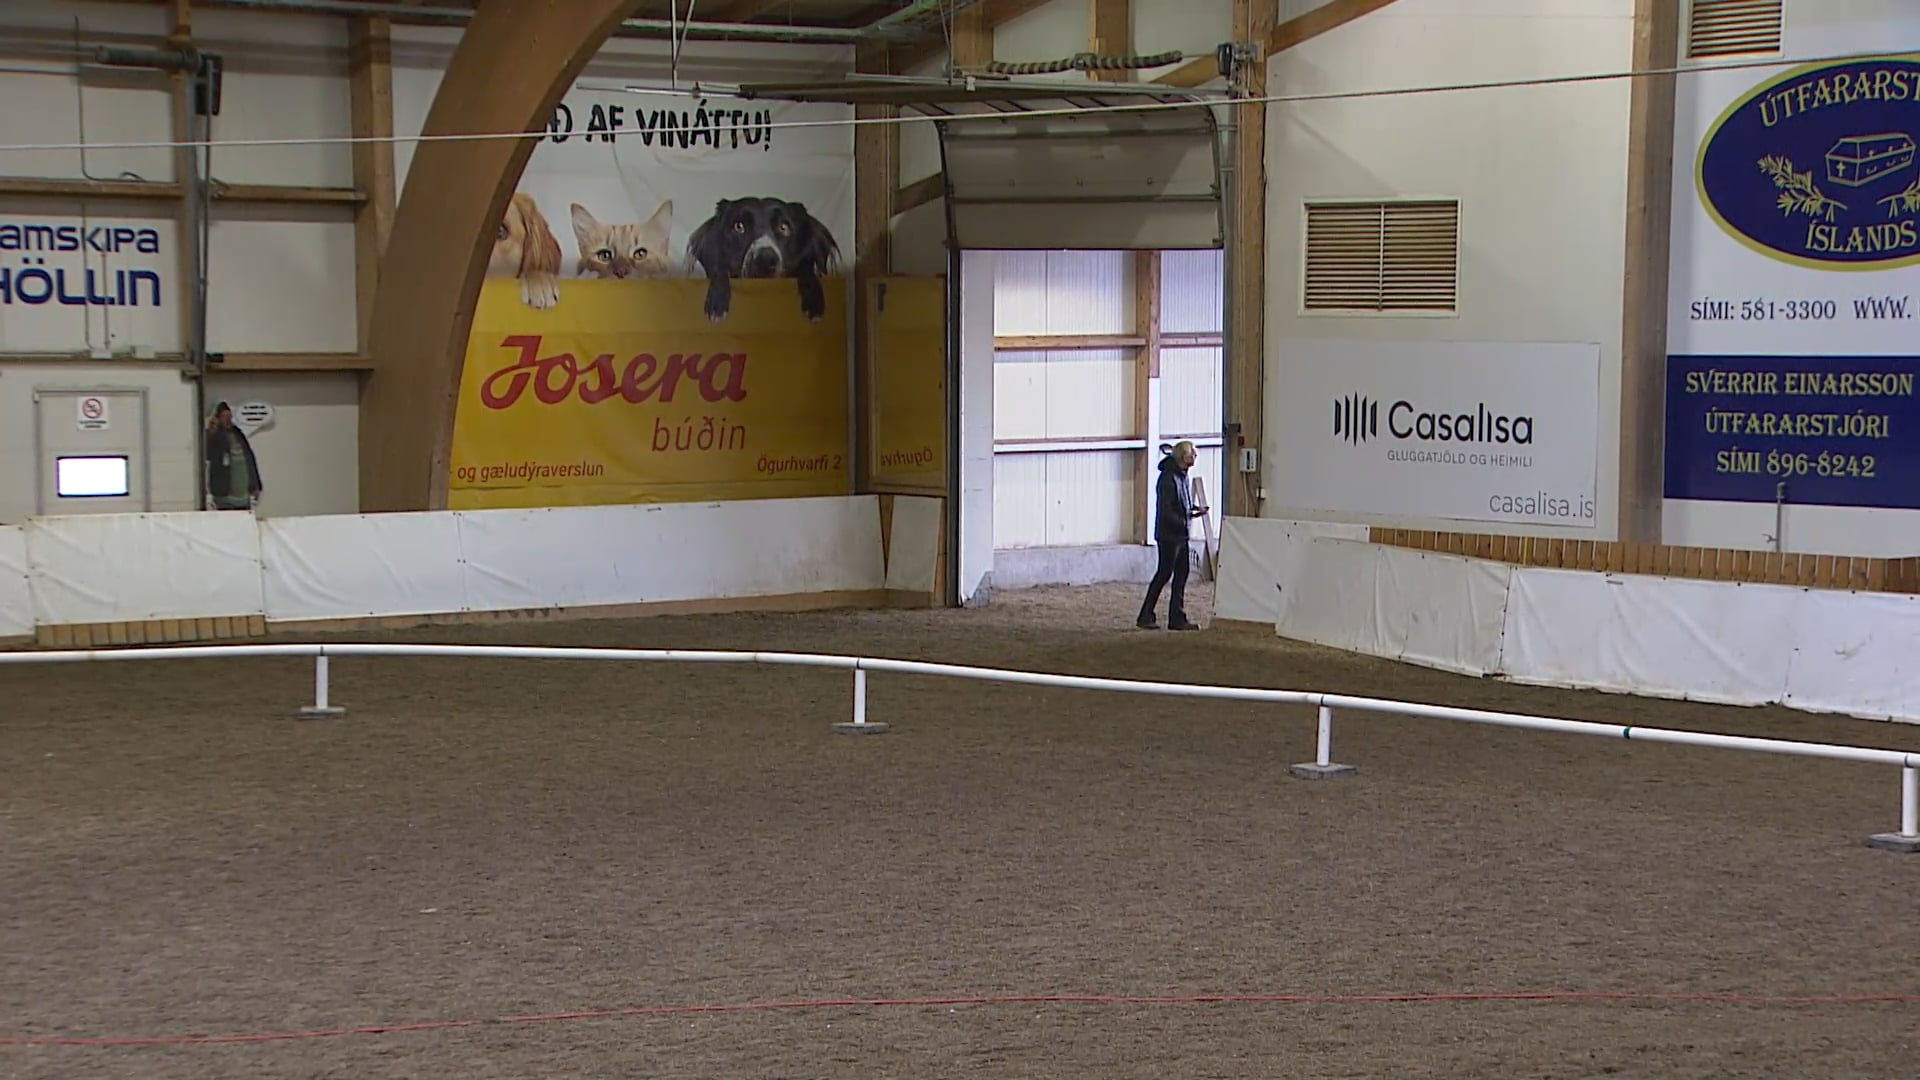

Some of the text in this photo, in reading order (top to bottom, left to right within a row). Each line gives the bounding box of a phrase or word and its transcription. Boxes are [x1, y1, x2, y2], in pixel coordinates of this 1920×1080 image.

[585, 104, 624, 144] AF
[635, 98, 772, 152] VINÁTTU!
[1805, 220, 1917, 252] ÍSLANDS
[1690, 297, 1734, 320] SÍMI:
[1740, 298, 1836, 321] 581-3300
[481, 335, 747, 410] Josera
[1685, 369, 1914, 396] SVERRIR EINARSSON
[652, 416, 747, 453] búðin
[1388, 401, 1533, 444] Casalisa
[1705, 407, 1889, 438] ÚTFARARSTJÓRI
[457, 460, 604, 483] og gæludýraverslun
[757, 453, 842, 475] Ögurhvarfi 2
[1387, 449, 1533, 468] GLUGGATJÖLD OG HEIMILI
[1716, 446, 1876, 478] SÍMI 896-8242
[1489, 490, 1595, 519] casalisa.is
